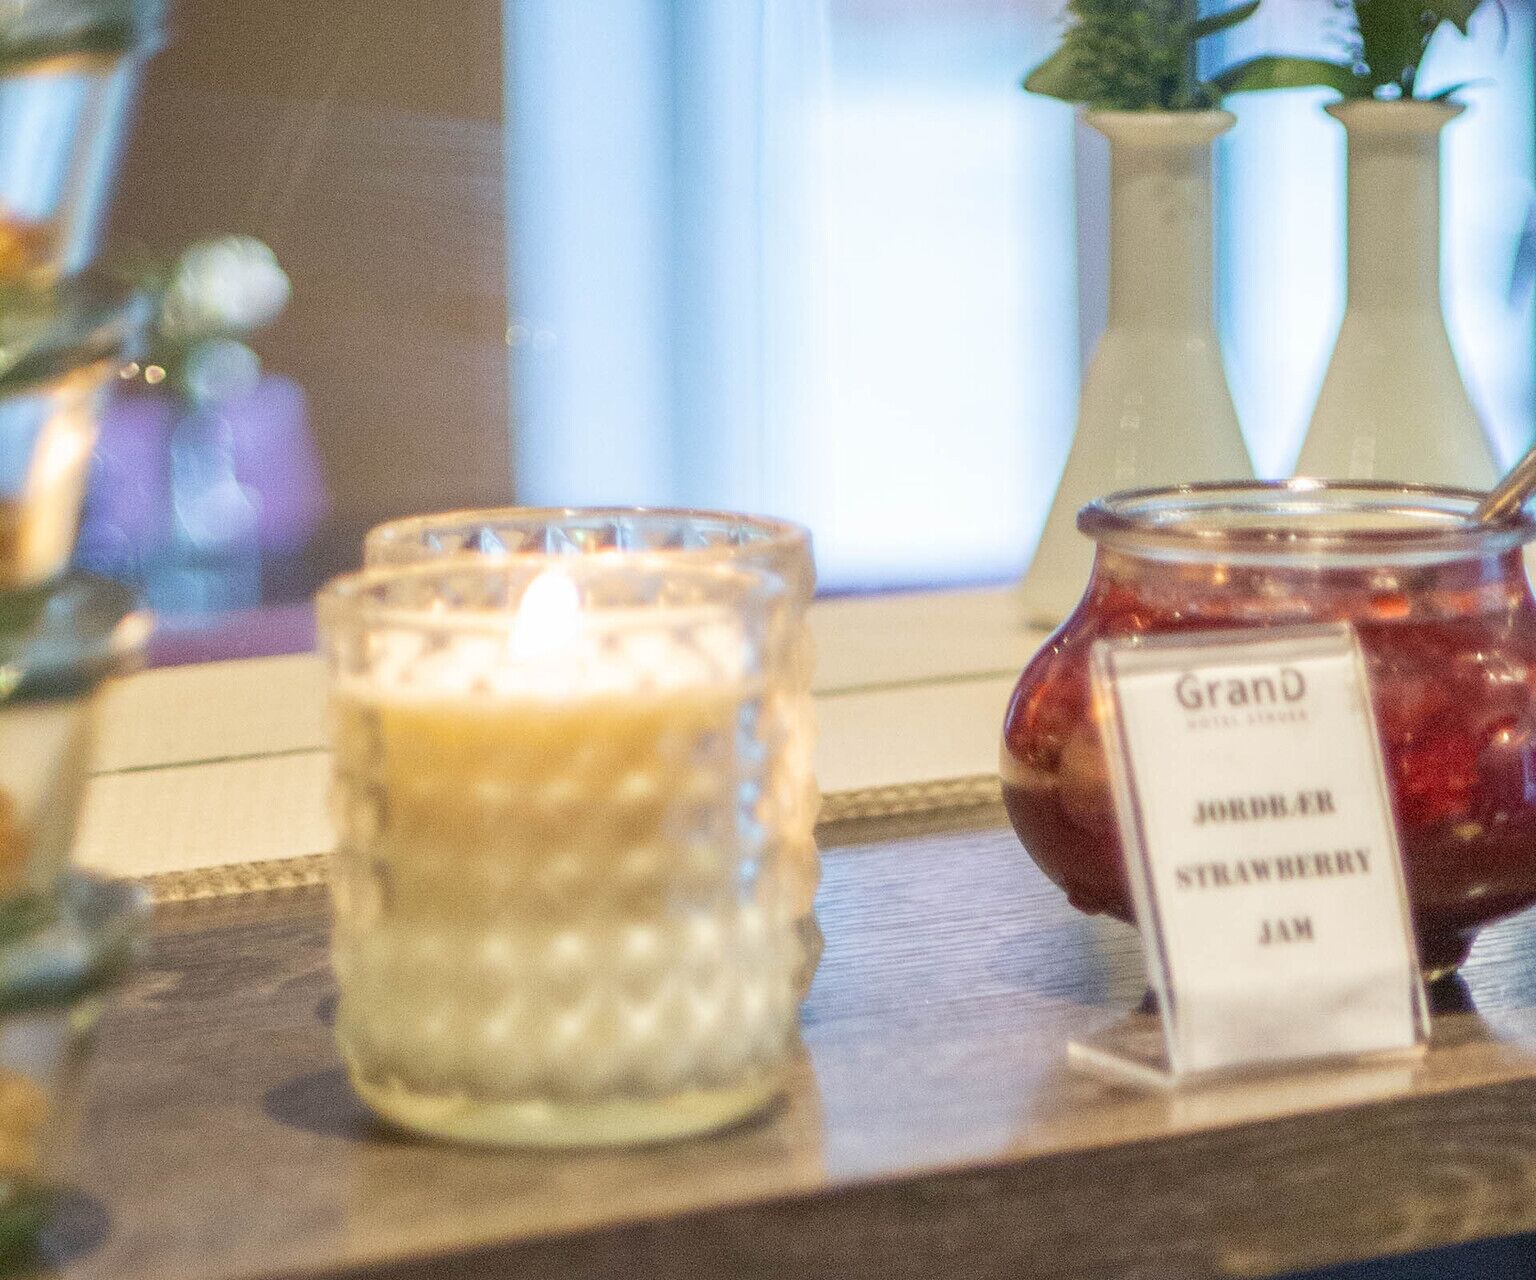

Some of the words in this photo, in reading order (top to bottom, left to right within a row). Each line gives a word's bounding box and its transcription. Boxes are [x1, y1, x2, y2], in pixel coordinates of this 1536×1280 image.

[1193, 791, 1336, 825] JORDBÆR
[1175, 849, 1372, 890] STRAWBERRY
[1258, 916, 1315, 946] JAM
